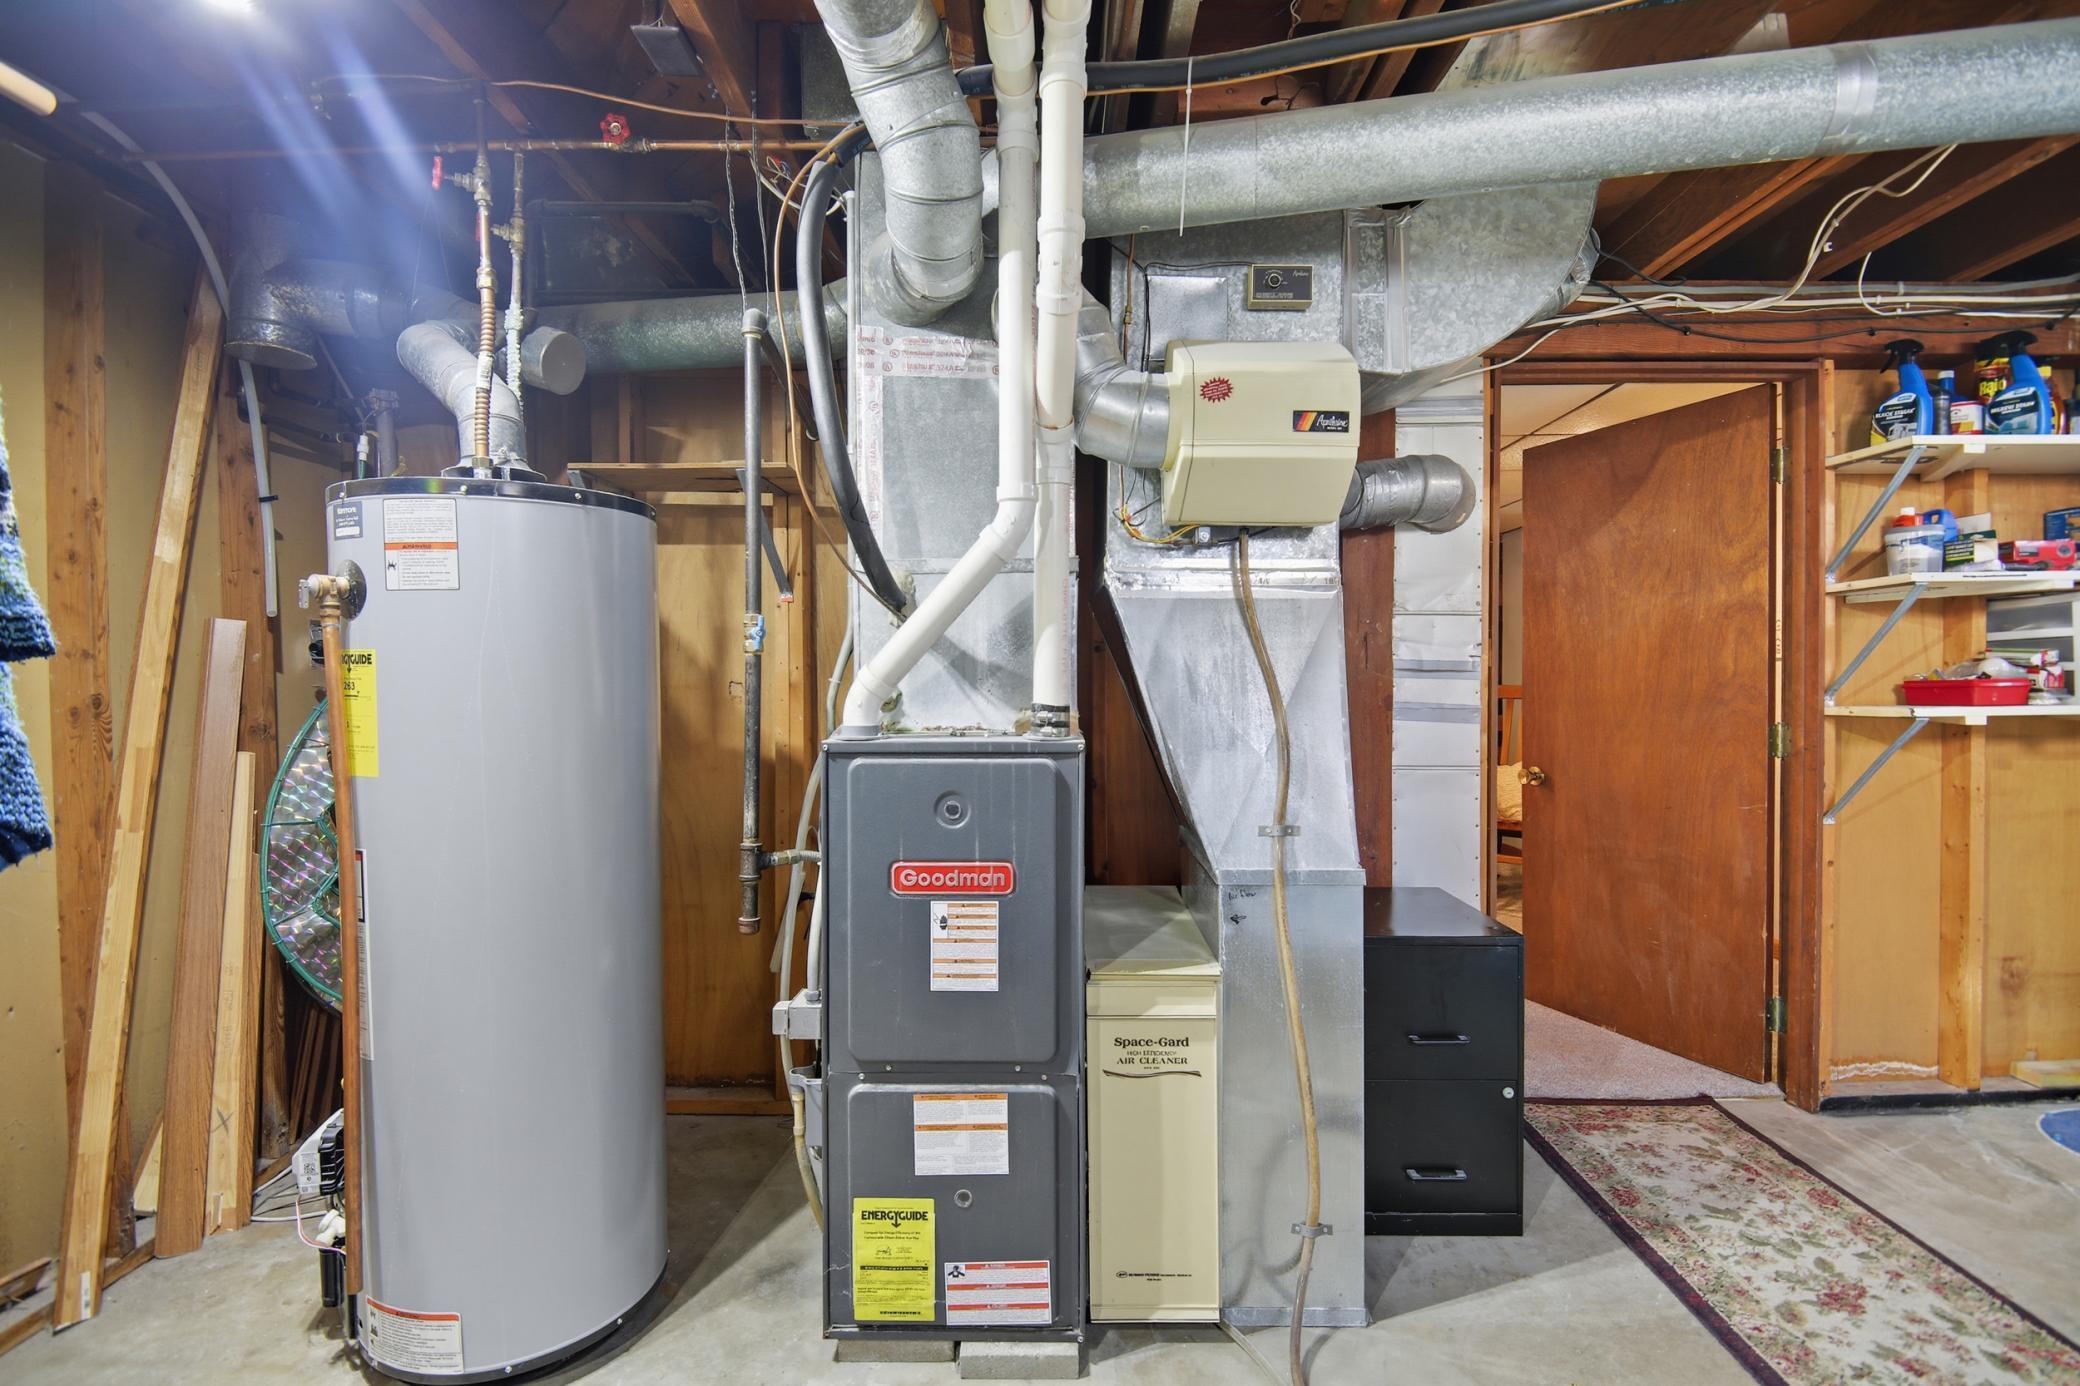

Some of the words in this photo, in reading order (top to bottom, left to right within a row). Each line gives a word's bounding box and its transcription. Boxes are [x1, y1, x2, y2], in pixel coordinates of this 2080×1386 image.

[900, 869, 1006, 887] Goodman
[1113, 1036, 1190, 1049] Space-Gard
[1117, 1057, 1135, 1065] AIR
[1139, 1057, 1188, 1065] CLEANER
[861, 1210, 929, 1226] ENERGYGUIDE
